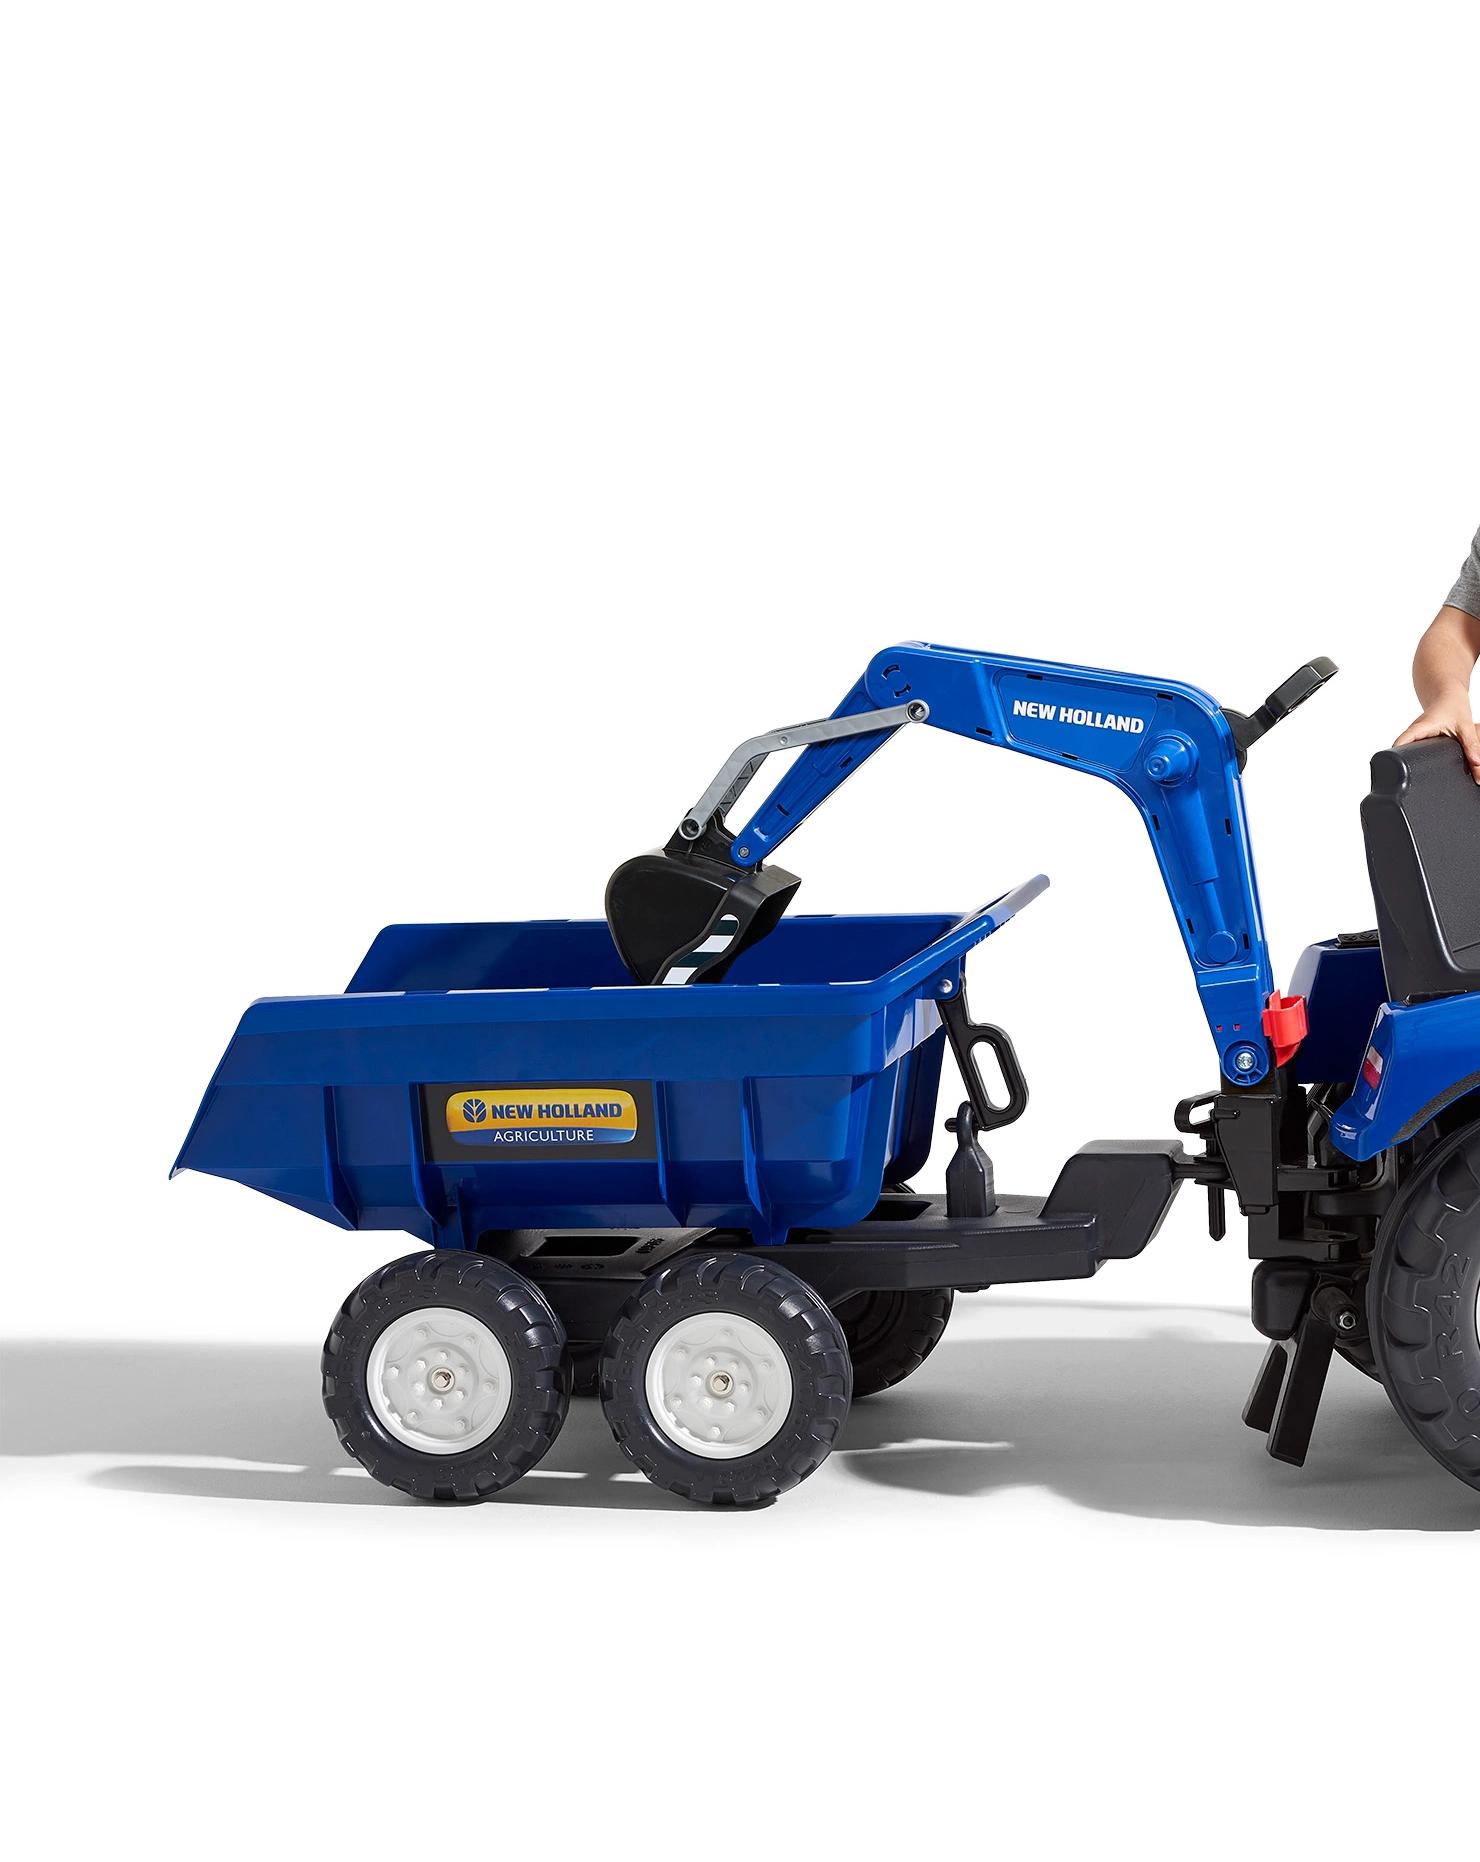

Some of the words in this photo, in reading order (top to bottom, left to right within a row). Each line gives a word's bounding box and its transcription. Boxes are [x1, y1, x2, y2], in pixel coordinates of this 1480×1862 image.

[1013, 700, 1056, 720] NEW
[1059, 706, 1144, 734] HOLLAND
[491, 1104, 533, 1119] NEW
[538, 1103, 622, 1119] HOLLAND
[493, 1129, 594, 1142] AGRICULTURE
[1435, 1252, 1472, 1370] R42
